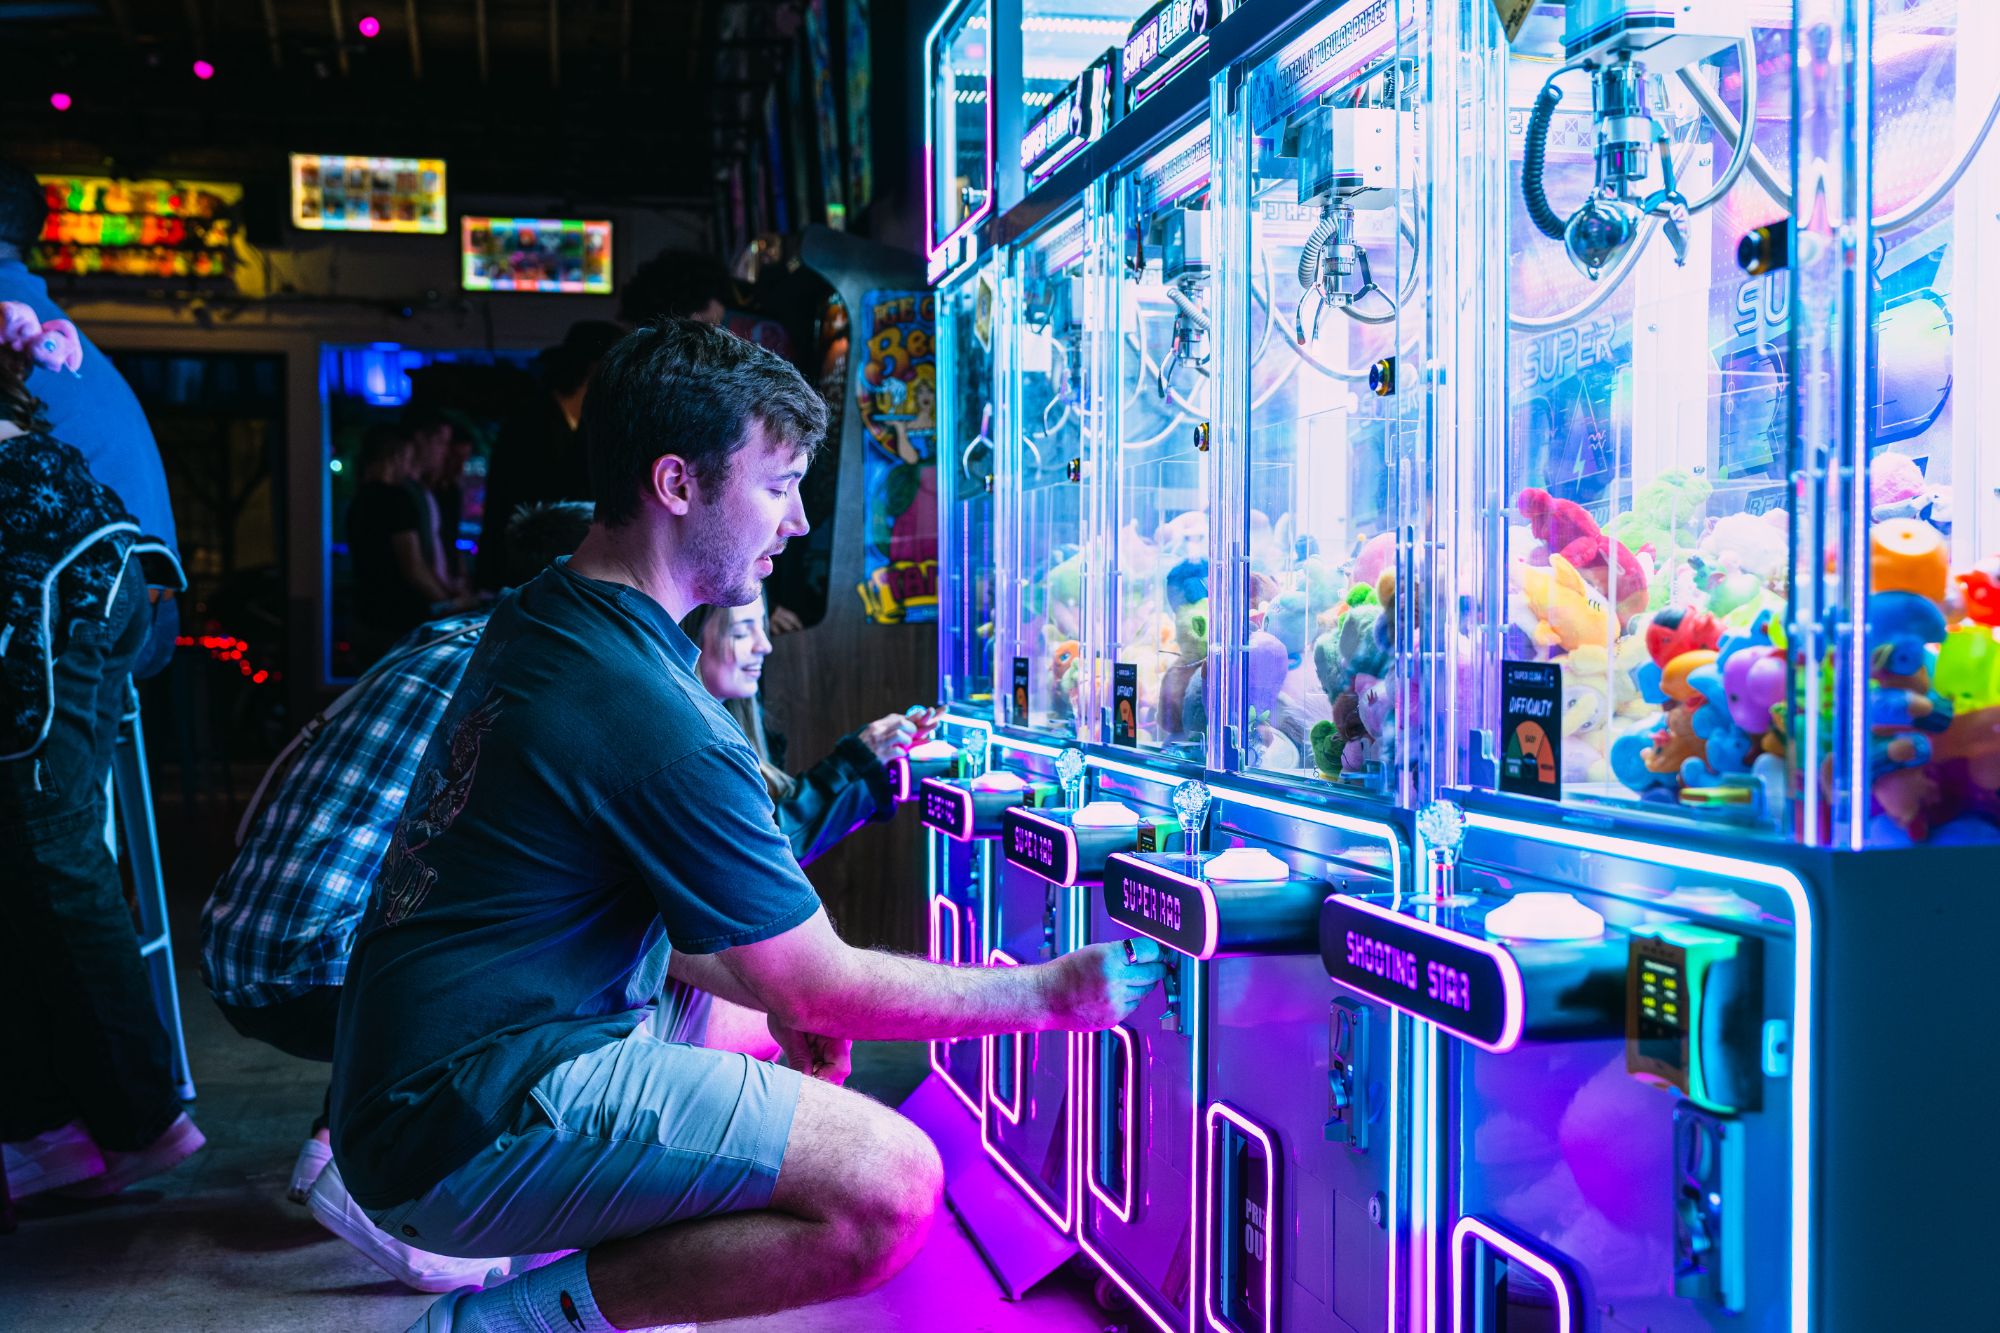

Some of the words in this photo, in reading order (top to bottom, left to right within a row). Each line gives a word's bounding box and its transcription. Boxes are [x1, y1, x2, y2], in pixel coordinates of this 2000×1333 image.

[1123, 22, 1158, 79] SUPER
[1159, 0, 1191, 49] CLAW
[1280, 47, 1314, 89] TOTALLY
[1314, 20, 1353, 68] TUBULAR
[1353, 0, 1388, 43] PRIZES
[1521, 313, 1617, 389] SUPER
[1509, 696, 1553, 717] DIFFICULTY
[1123, 877, 1157, 921] SUPER
[1159, 891, 1181, 932] RAD
[1346, 930, 1418, 991] SHOOTING
[1427, 960, 1471, 1012] STAR
[1245, 1223, 1264, 1262] OU
